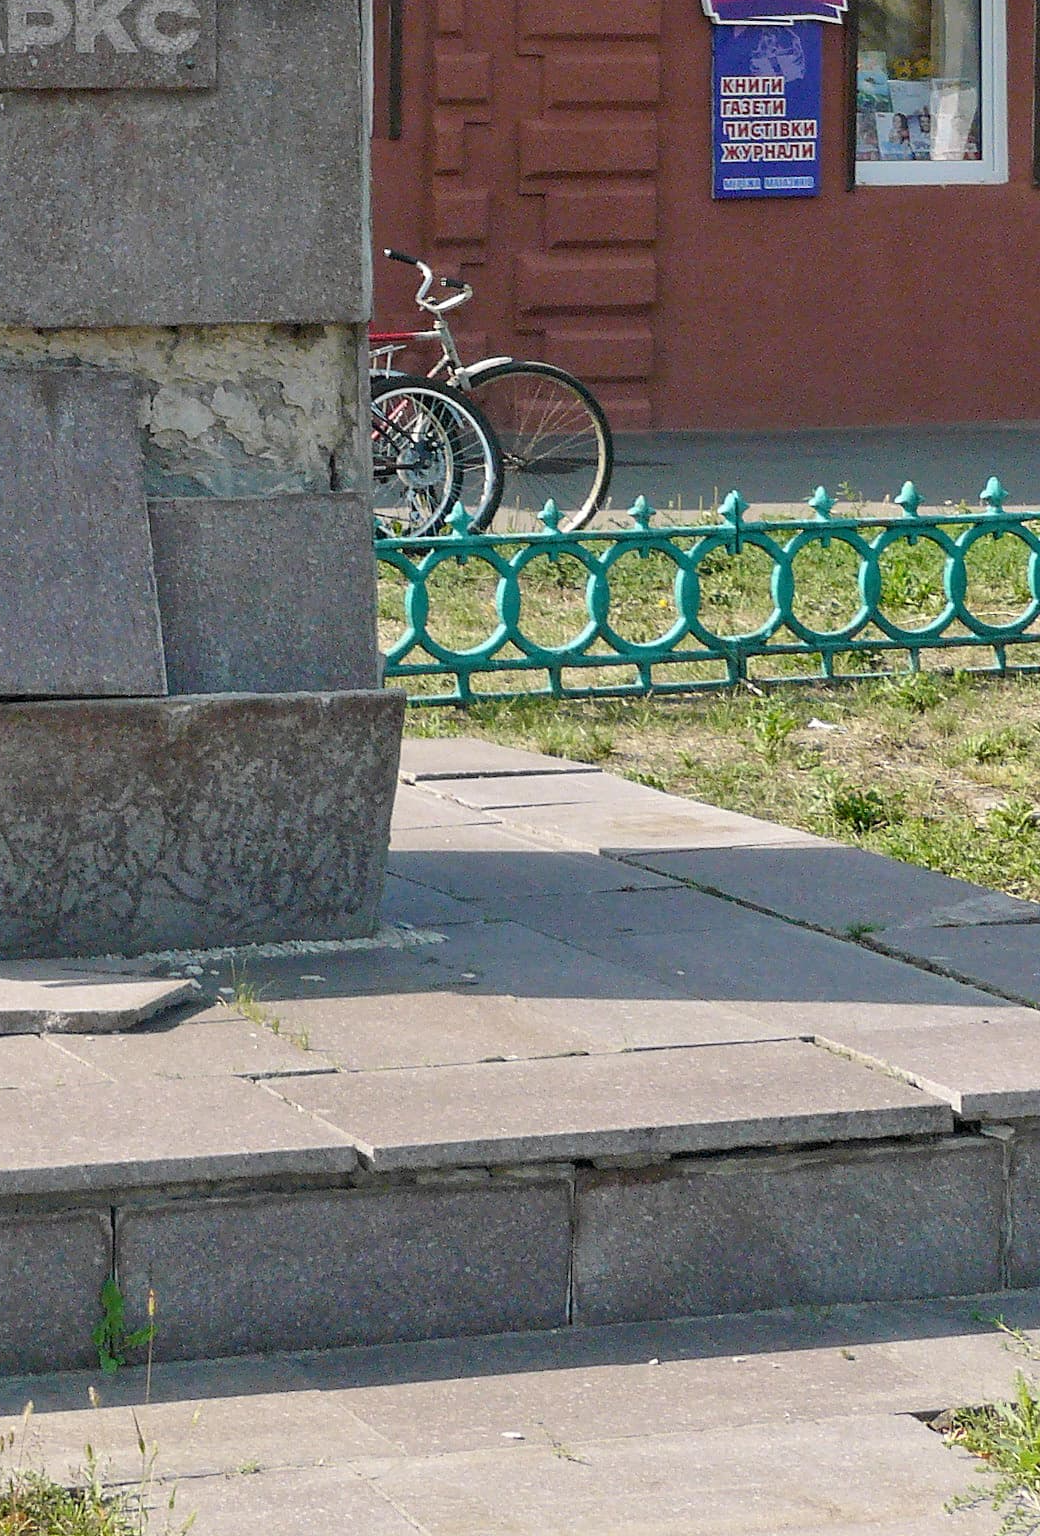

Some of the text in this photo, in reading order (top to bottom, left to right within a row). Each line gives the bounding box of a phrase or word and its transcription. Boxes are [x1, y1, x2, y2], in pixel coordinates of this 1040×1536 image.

[721, 77, 784, 94] КНИГИ
[721, 99, 785, 116] ГАЗЕТИ
[722, 143, 815, 160] ЖУРНАЛИ
